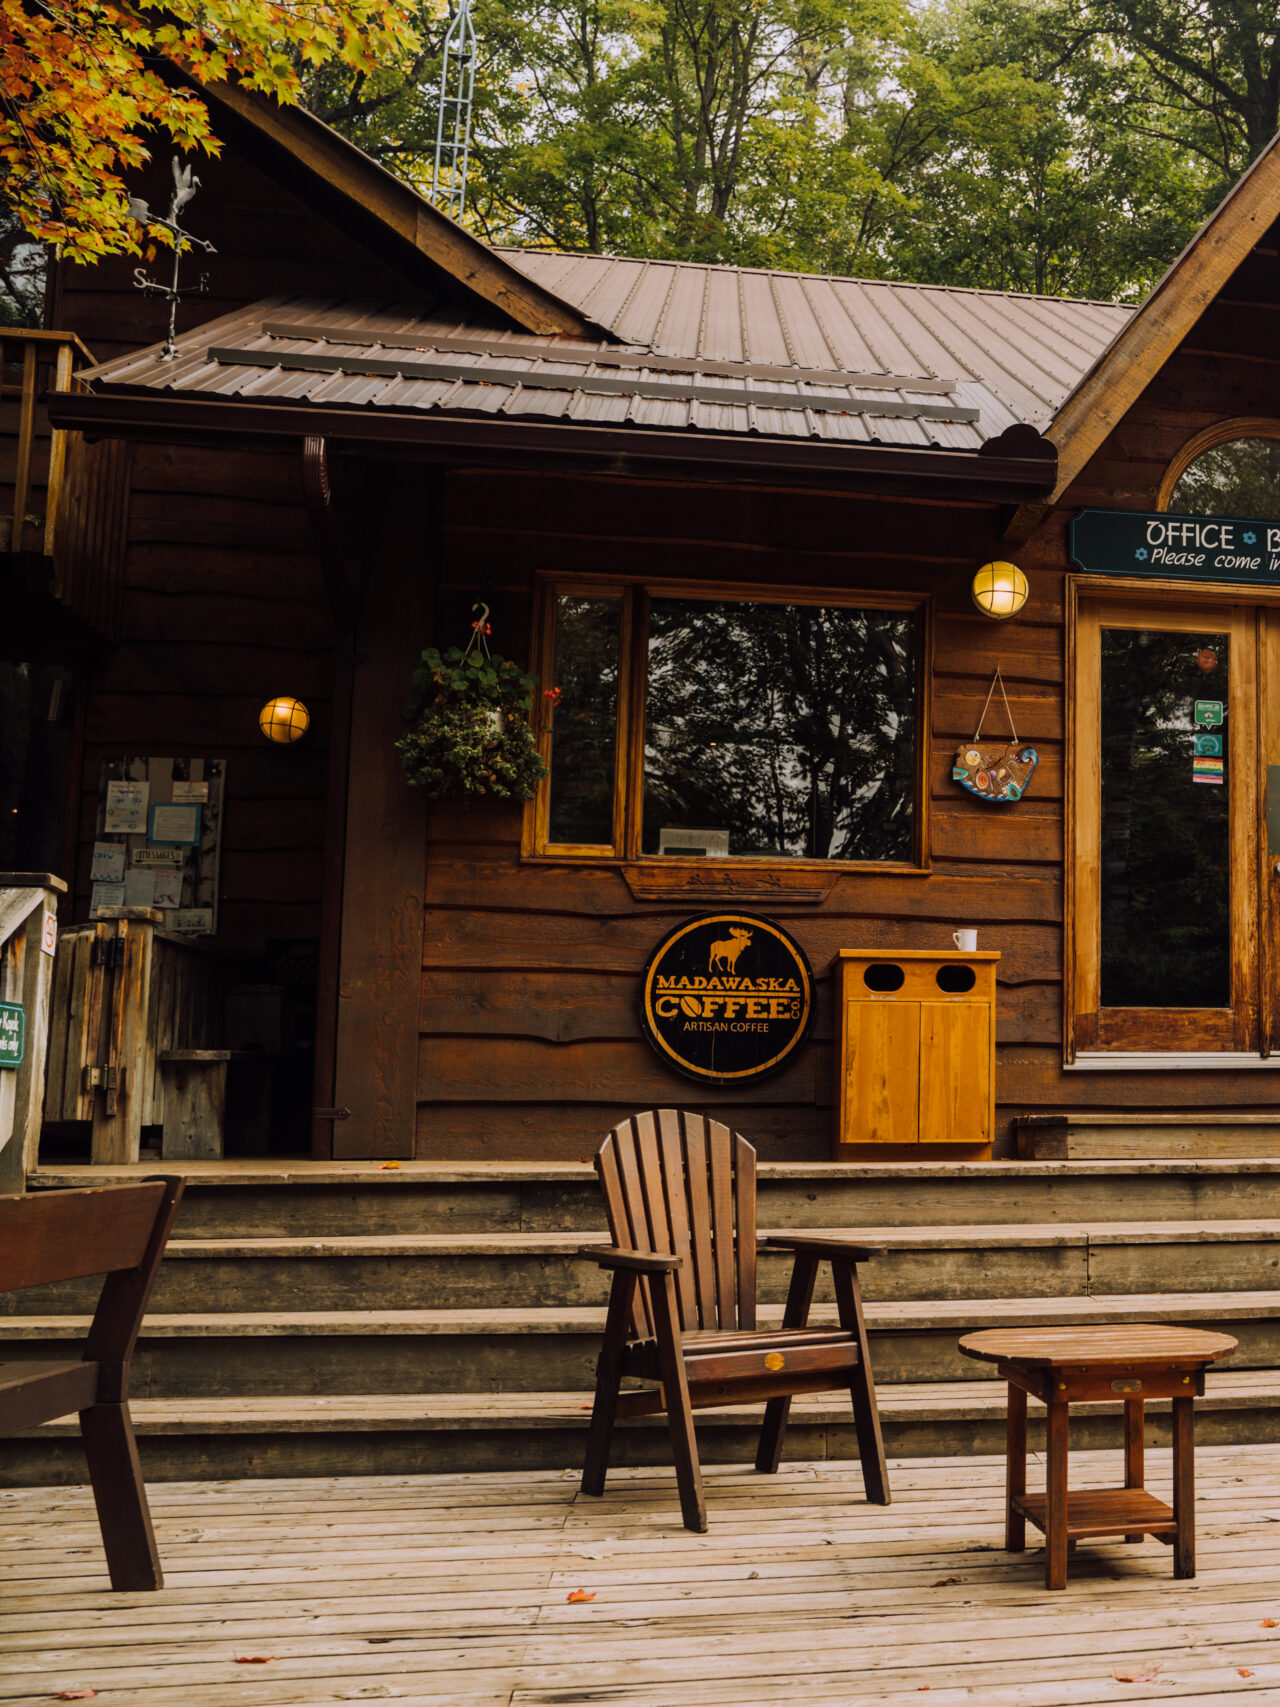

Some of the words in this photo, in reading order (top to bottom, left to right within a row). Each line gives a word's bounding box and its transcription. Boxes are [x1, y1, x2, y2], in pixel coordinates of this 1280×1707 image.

[1146, 520, 1235, 550] OFFICE
[1150, 547, 1206, 567] Please
[1214, 554, 1261, 570] come
[656, 975, 800, 991] MADAWASKA
[655, 995, 790, 1019] COFFEE
[683, 1021, 728, 1032] ARTISAN
[730, 1022, 769, 1033] COFFEE
